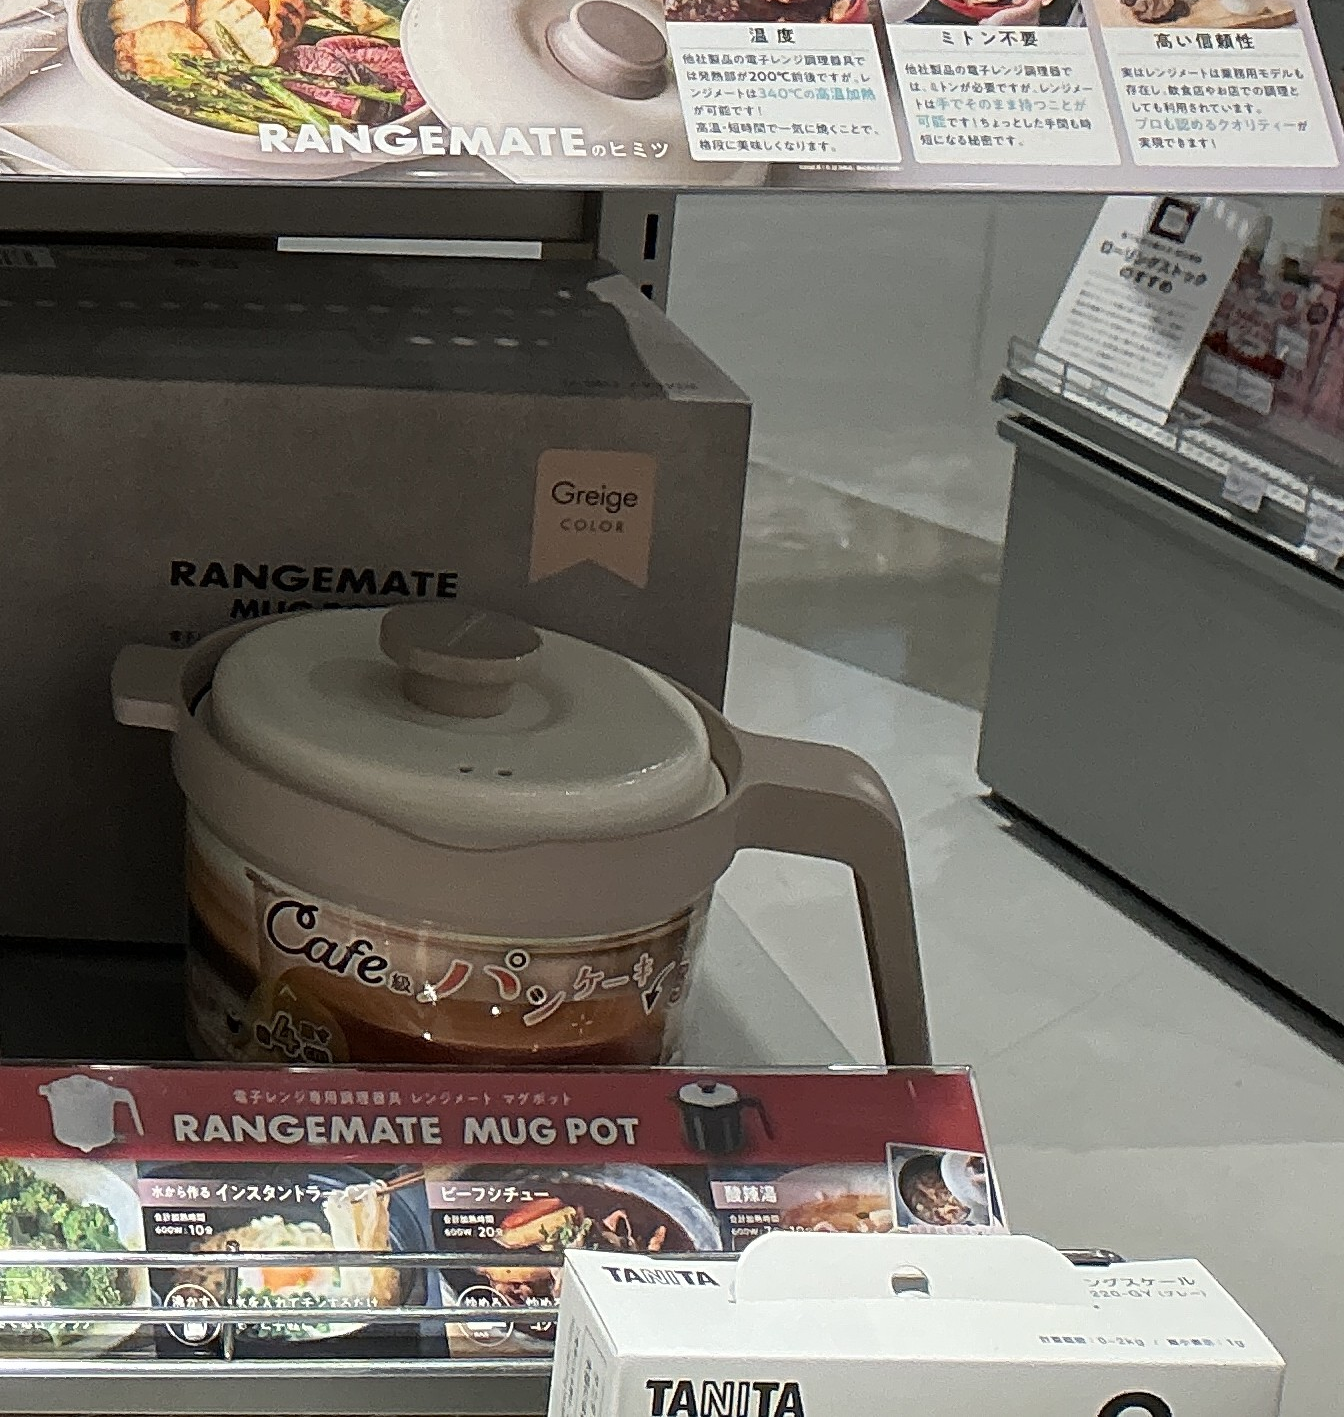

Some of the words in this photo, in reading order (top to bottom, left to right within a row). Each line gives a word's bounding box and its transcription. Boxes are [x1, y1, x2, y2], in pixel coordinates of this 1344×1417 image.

[749, 27, 796, 44] 温度
[941, 30, 1039, 48] ミトン不要
[1153, 32, 1255, 50] 高い信頼性
[551, 480, 640, 514] Greige
[559, 519, 626, 533] COLOR
[170, 559, 459, 599] RANGEMATE
[173, 1113, 442, 1145] RANGEMATE
[463, 1116, 557, 1145] MUG
[566, 1117, 639, 1146] POT
[440, 1186, 551, 1204] ビーフシチュー
[601, 1265, 721, 1288] TANITA
[646, 1379, 806, 1417] TANITA
